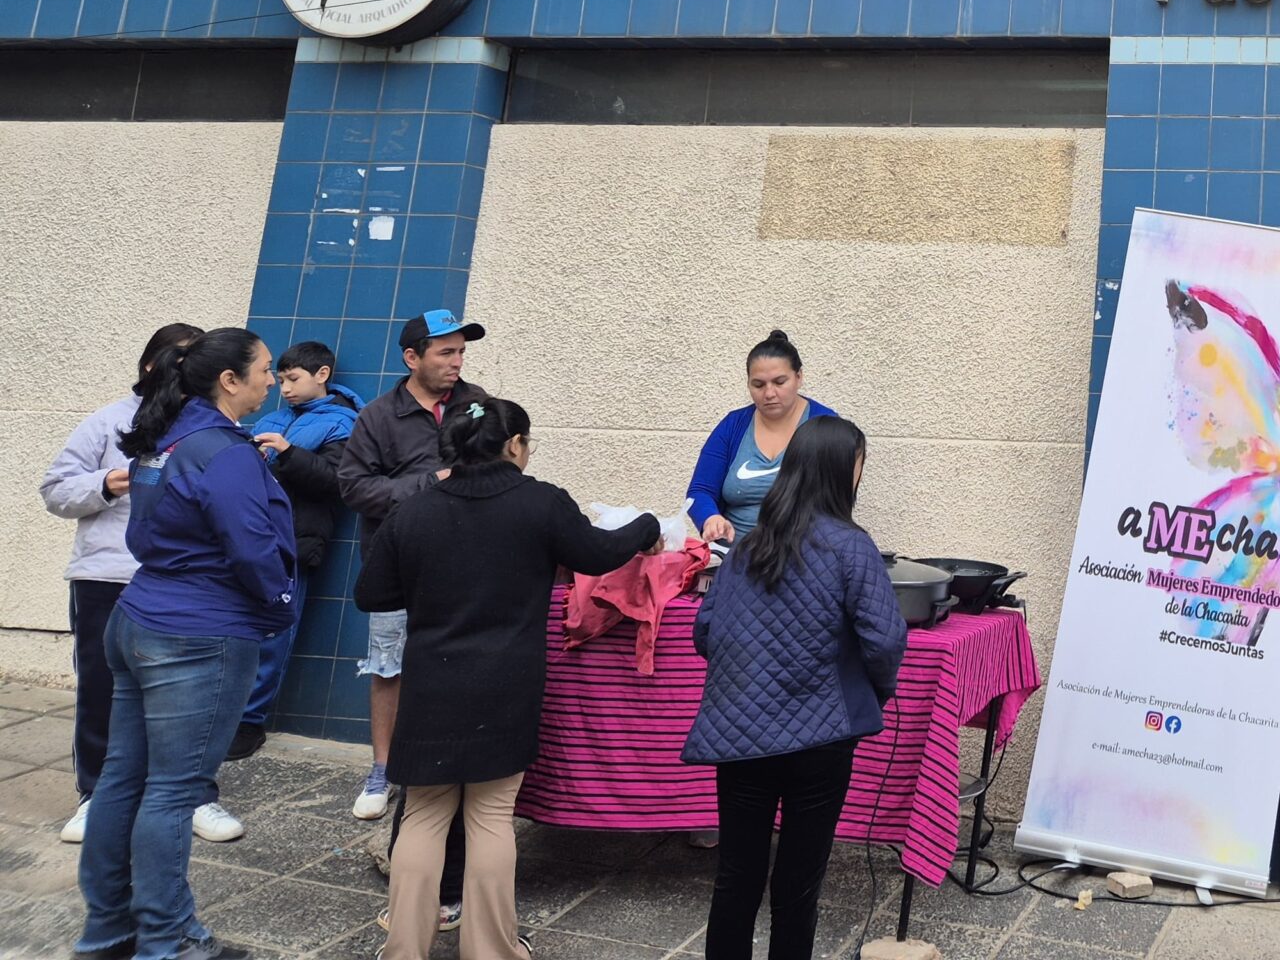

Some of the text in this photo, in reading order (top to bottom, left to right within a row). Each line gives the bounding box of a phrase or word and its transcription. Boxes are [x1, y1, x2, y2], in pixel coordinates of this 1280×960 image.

[1078, 555, 1143, 583] Asociación
[1147, 569, 1200, 594] Mujeres
[1164, 596, 1249, 628] de la Chacarita
[1159, 629, 1265, 660] #CrecemosJuntas
[1057, 679, 1279, 729] Asociación de Mujeres Emprendedoras de la Chacarita
[1091, 740, 1223, 774] e-mail: amecha23@hotmail.com
